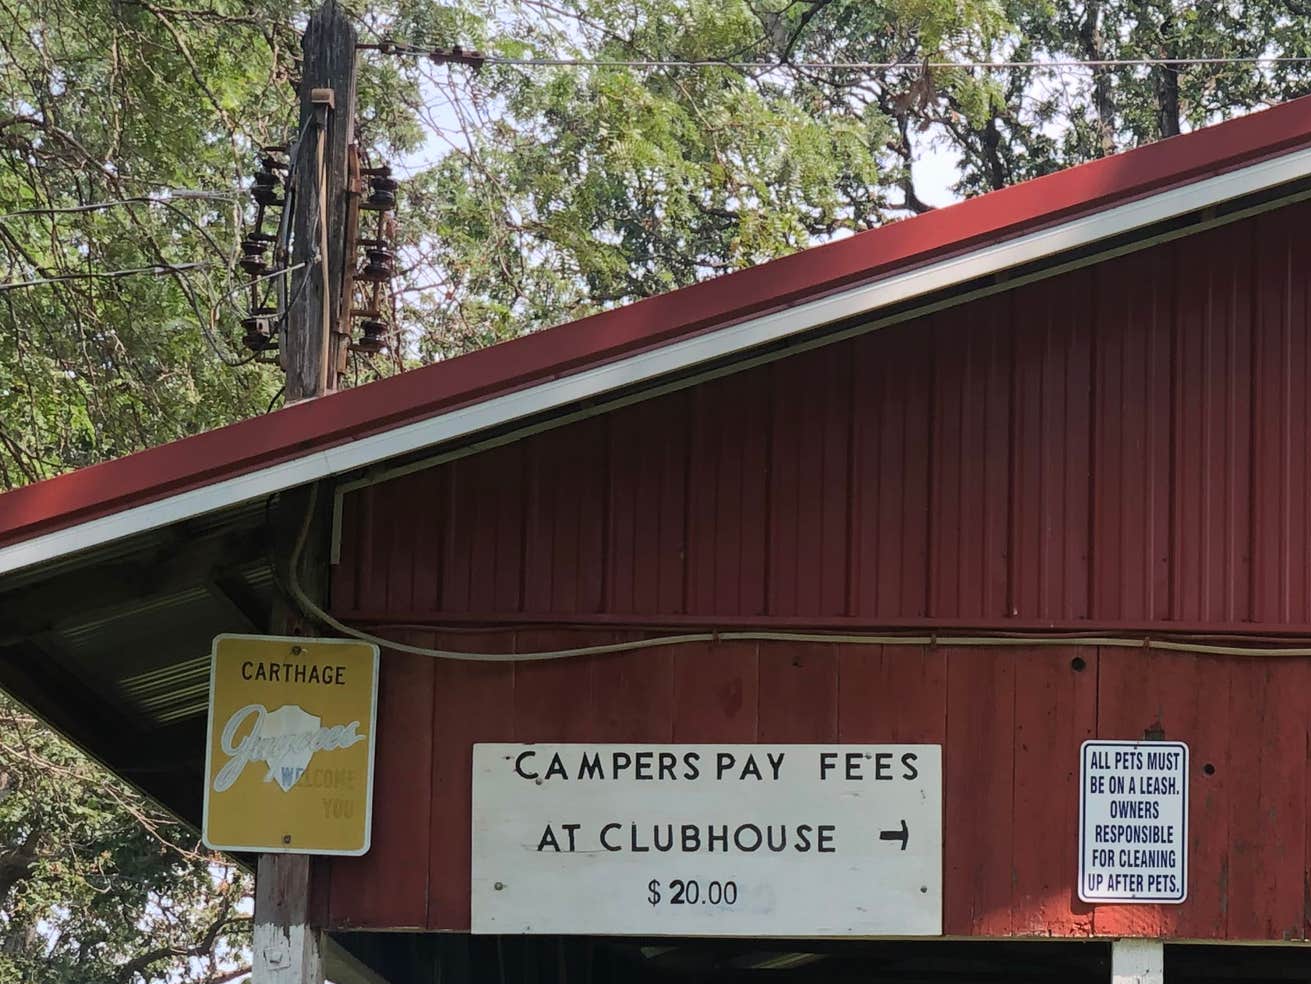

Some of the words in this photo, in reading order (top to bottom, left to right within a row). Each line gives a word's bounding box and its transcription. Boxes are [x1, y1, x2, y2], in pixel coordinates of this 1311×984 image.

[241, 661, 347, 685] CARTHAGE
[515, 750, 700, 781] CAMPERS
[716, 752, 785, 781] PAY
[820, 752, 919, 781] FEES
[1090, 751, 1111, 770] ALL
[1114, 752, 1143, 770] PETS
[1147, 752, 1180, 770] MUST
[1090, 776, 1105, 794] BE
[1109, 776, 1125, 794] ON
[1128, 776, 1136, 795] A
[1140, 777, 1180, 795] LEASH.
[322, 798, 354, 819] YOU
[1110, 800, 1159, 819] OWNERS
[537, 823, 581, 853] AT
[599, 822, 837, 853] CLUBHOUSE
[1095, 825, 1174, 844] RESPONSIBLE
[1092, 849, 1115, 868] FOR
[1119, 849, 1176, 868] CLEANING
[1088, 873, 1103, 891] UP
[1107, 874, 1143, 892] AFTER
[1148, 874, 1180, 893] PETS.
